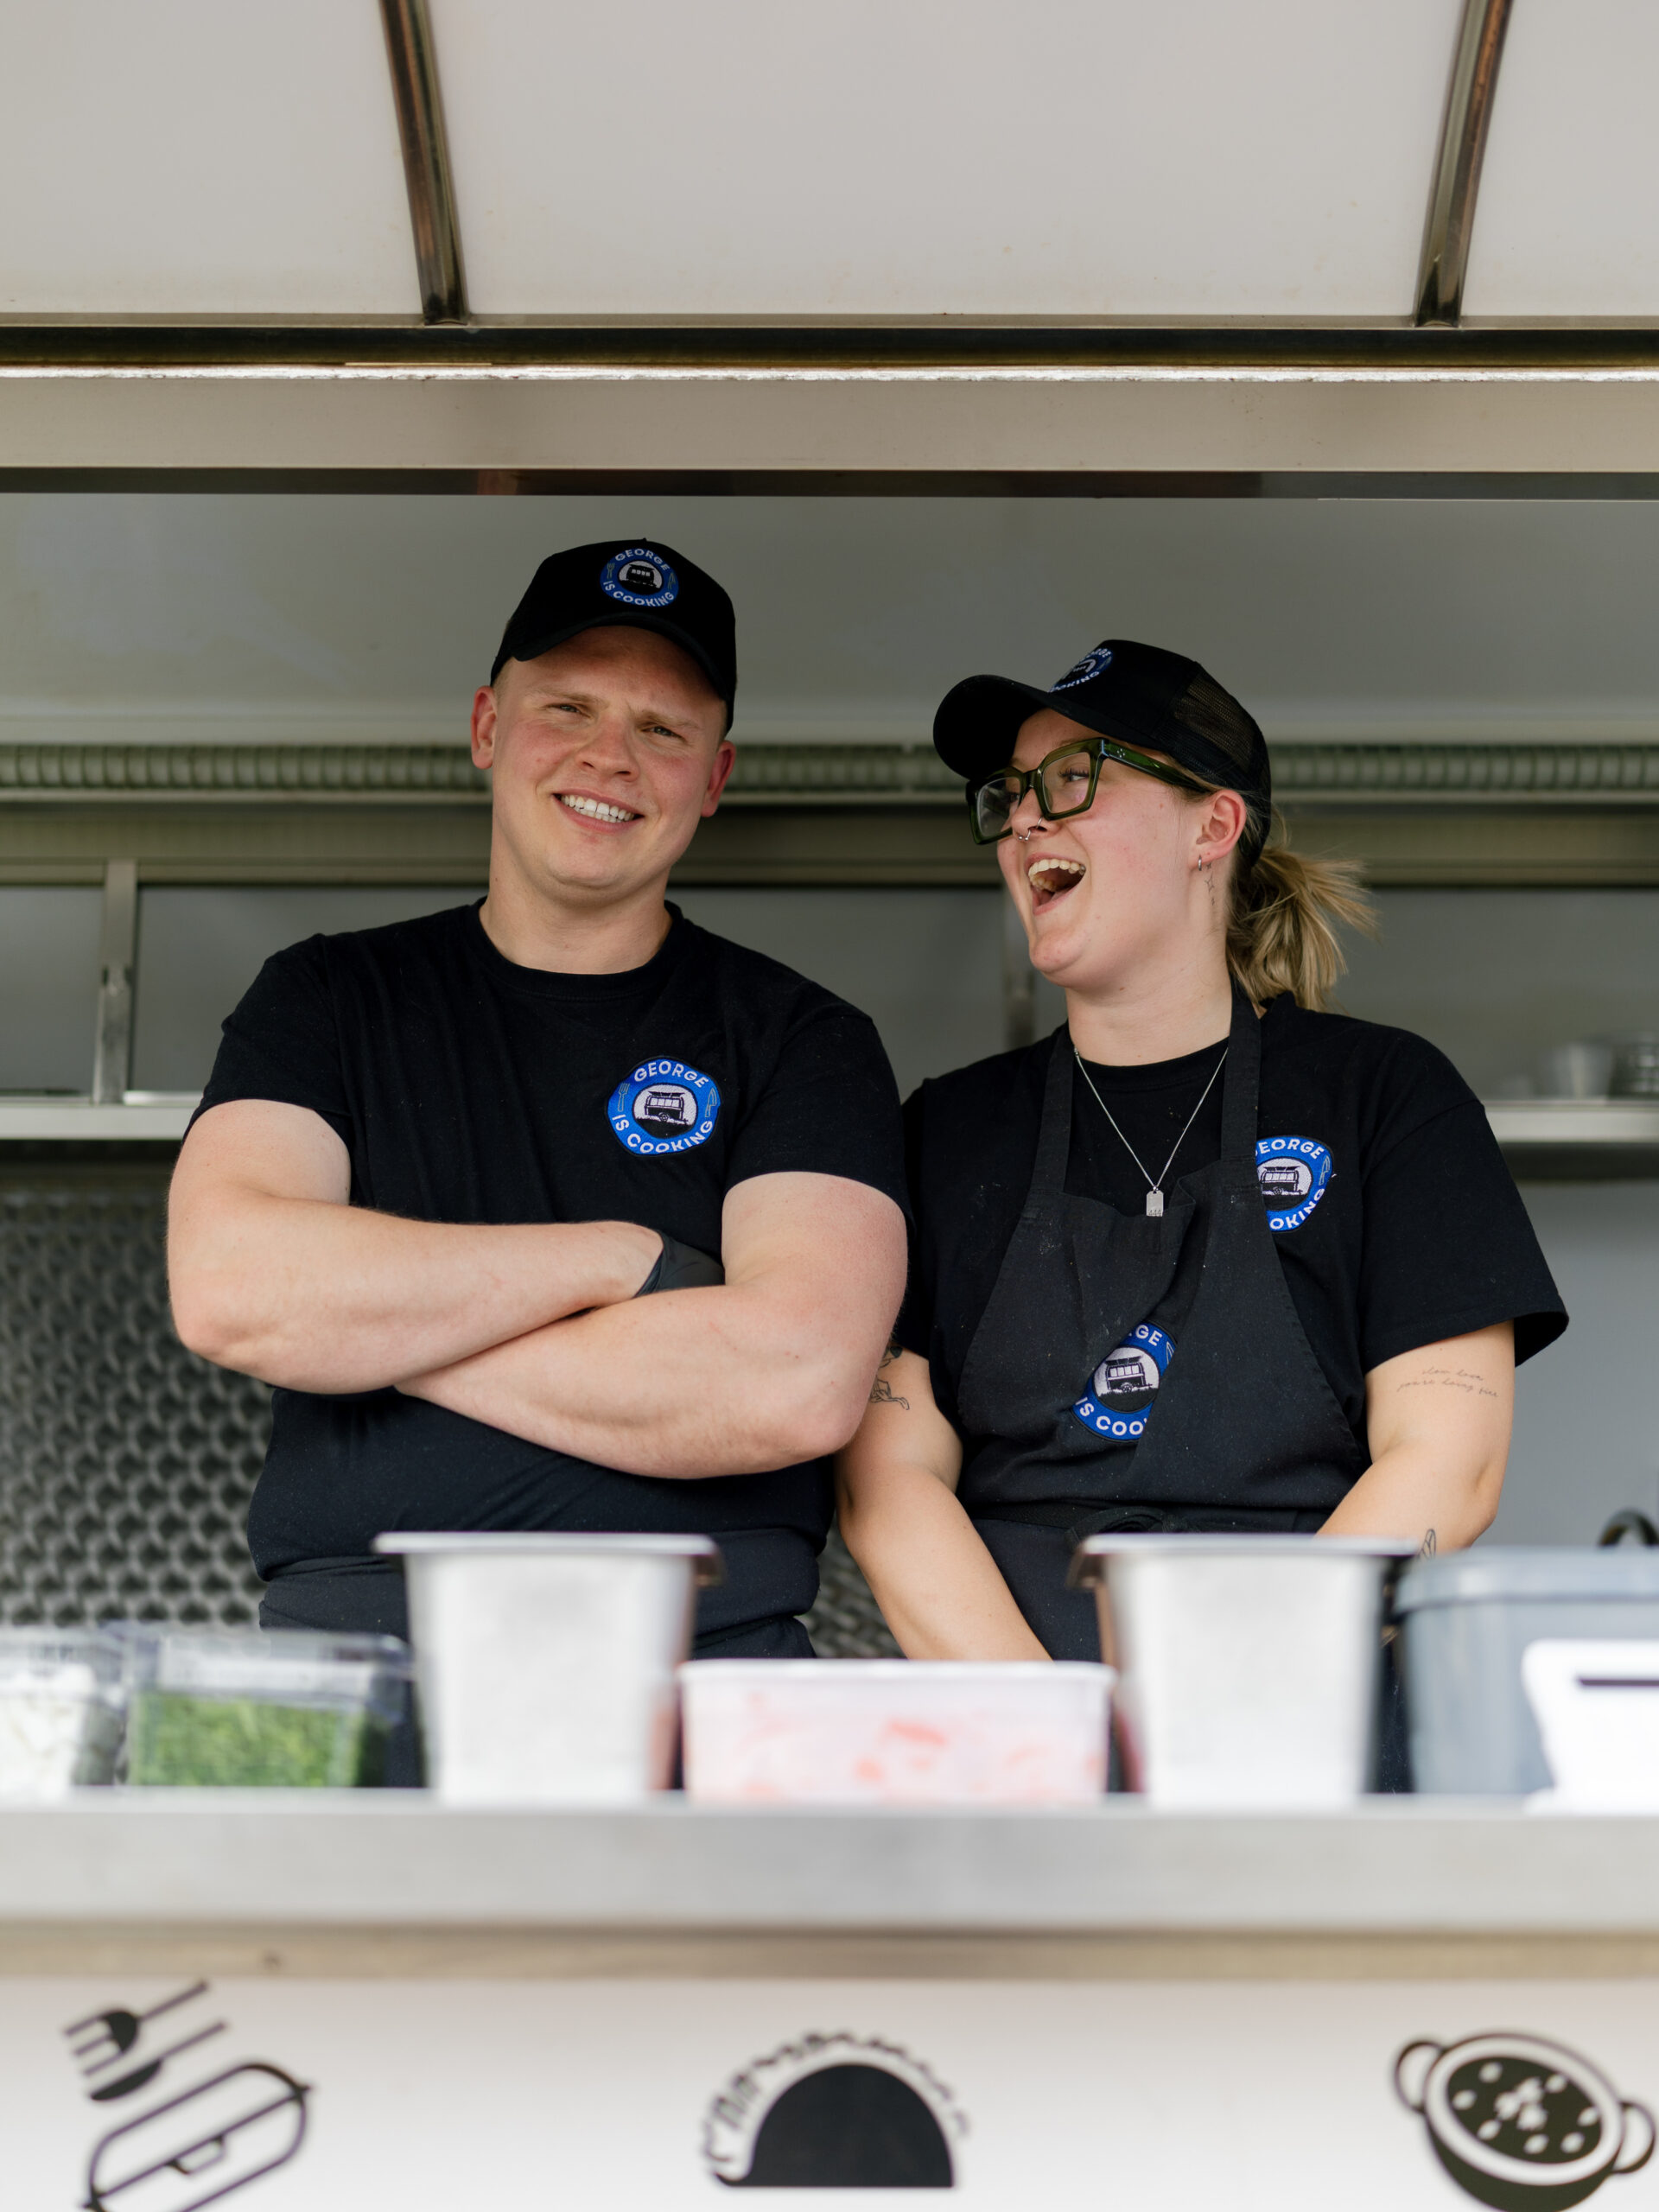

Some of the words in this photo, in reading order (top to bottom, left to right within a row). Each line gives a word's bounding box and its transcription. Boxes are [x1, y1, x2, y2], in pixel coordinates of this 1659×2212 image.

[615, 548, 671, 571] GEORGE
[603, 580, 615, 591] IS
[613, 592, 675, 607] COOKING
[634, 1060, 709, 1088] GEORGE
[612, 1114, 630, 1131] IS
[626, 1120, 714, 1154] COOKING
[1255, 1139, 1325, 1160] EORGE
[1269, 1188, 1325, 1230] OKING
[1128, 1325, 1163, 1346] GE
[1075, 1396, 1095, 1416] IS
[1096, 1415, 1147, 1436] COO
